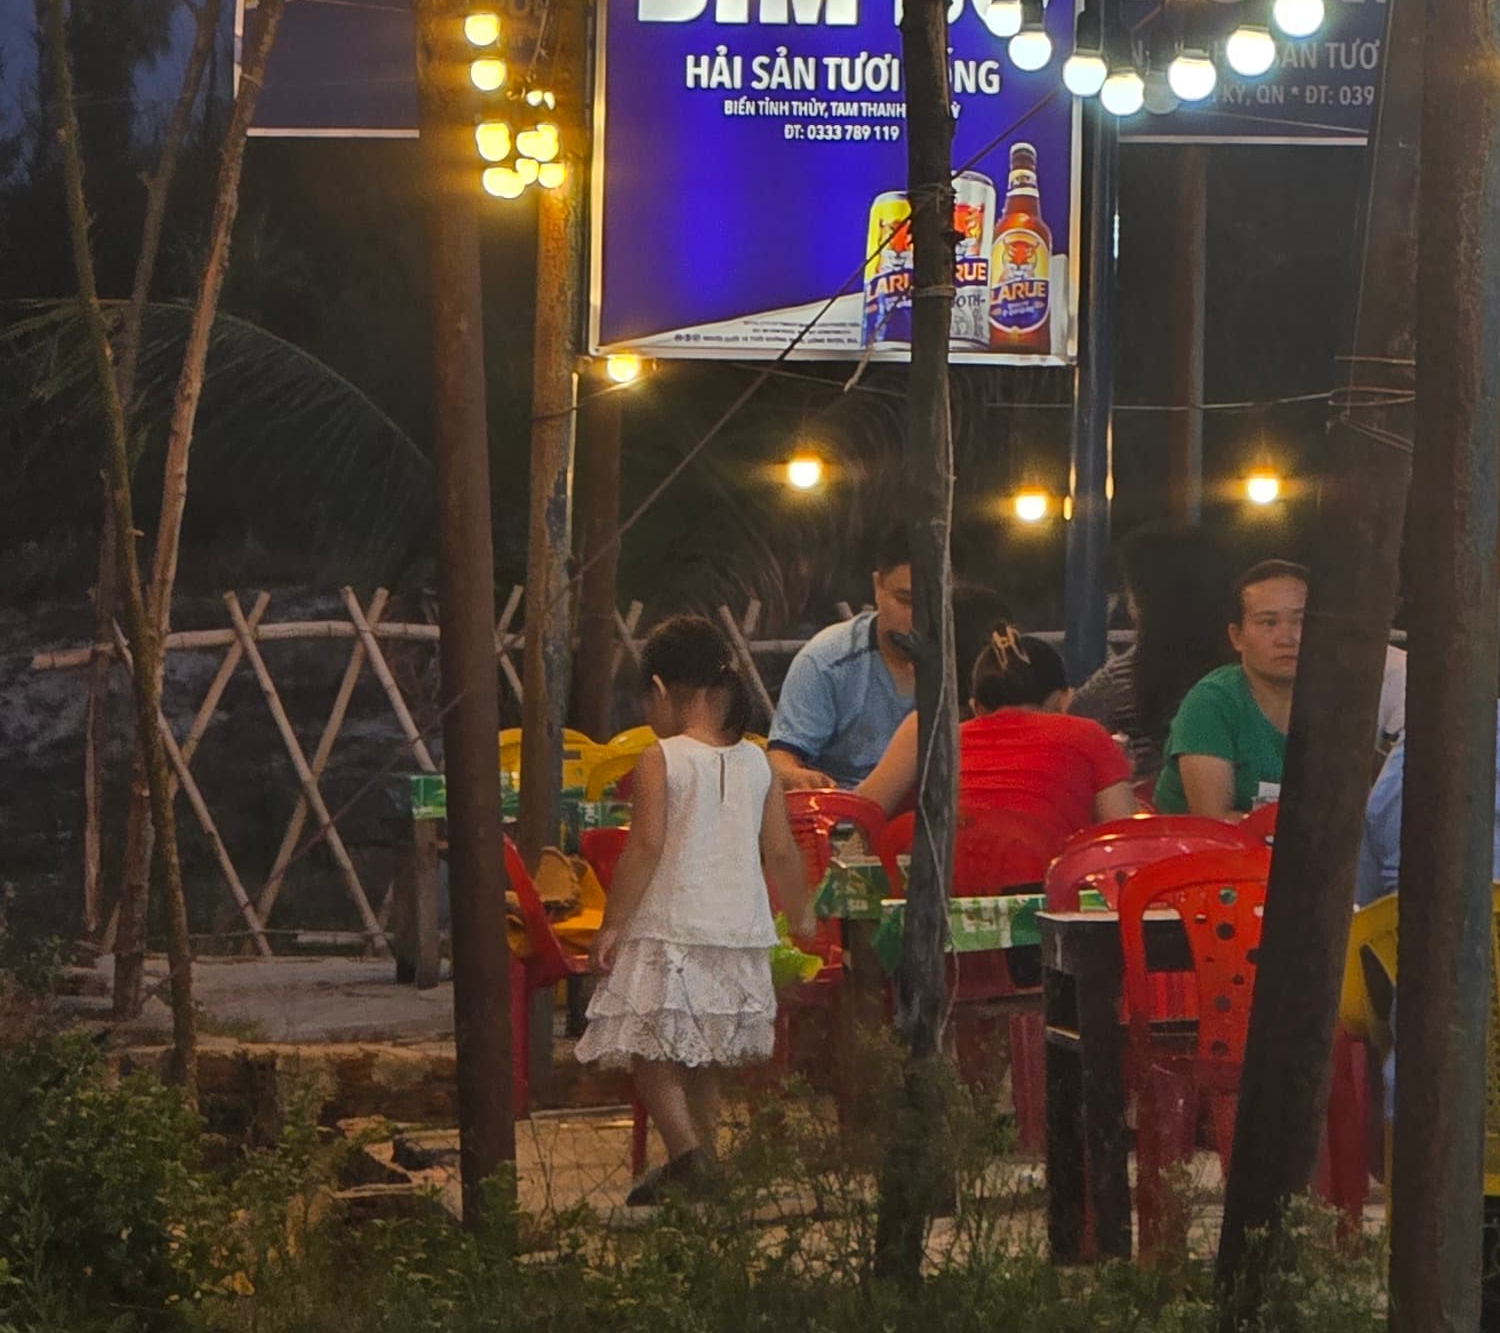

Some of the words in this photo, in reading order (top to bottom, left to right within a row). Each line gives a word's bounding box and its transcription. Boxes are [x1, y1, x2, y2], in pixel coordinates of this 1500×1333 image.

[686, 45, 742, 90] HẢI
[751, 46, 816, 90] SẢN
[823, 51, 900, 92] TƯƠI
[947, 47, 1001, 94] NG
[830, 101, 858, 118] TAM
[807, 124, 842, 141] 0333
[844, 125, 871, 141] 789
[874, 125, 899, 141] 119
[990, 281, 1047, 306] LARUE
